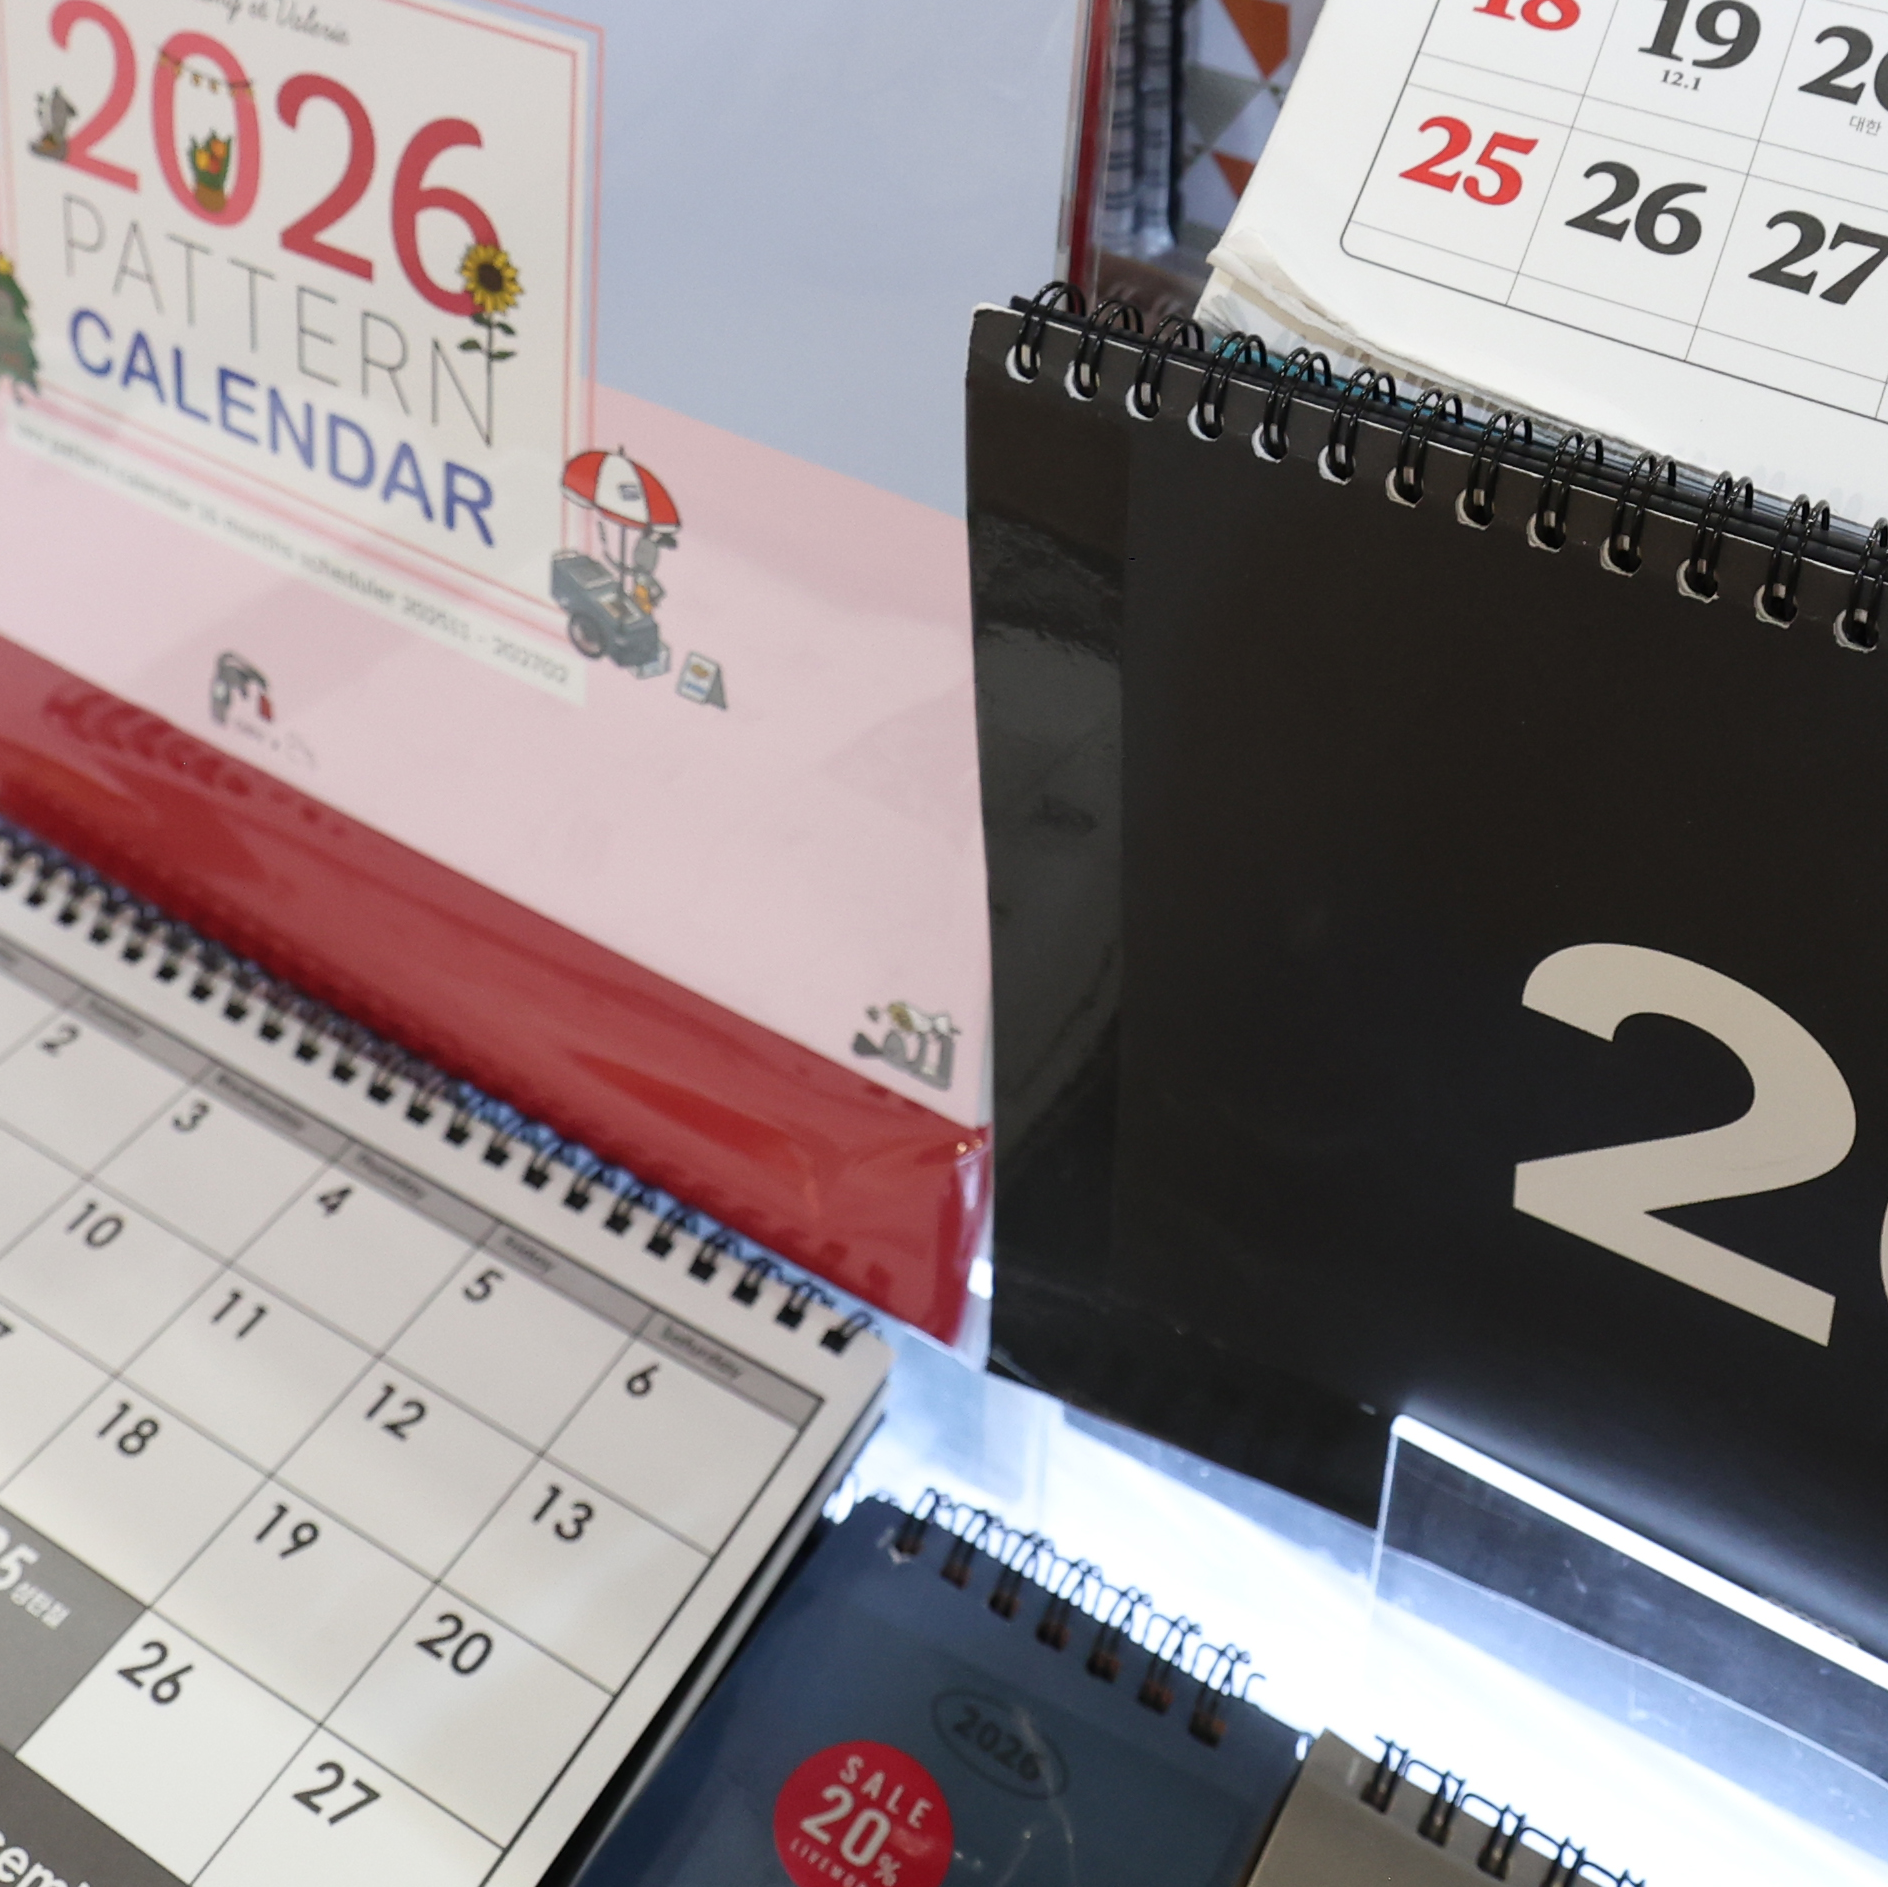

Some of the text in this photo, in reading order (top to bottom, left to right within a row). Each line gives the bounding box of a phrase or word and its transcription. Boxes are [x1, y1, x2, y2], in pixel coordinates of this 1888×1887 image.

[1662, 70, 1701, 91] 12.1
[1398, 115, 1539, 206] 25
[1564, 160, 1708, 256] 26
[57, 190, 496, 449] PATTERN
[67, 307, 498, 550] CALENDAR
[41, 1025, 80, 1054] 2
[172, 1100, 211, 1132] 3
[317, 1186, 353, 1215] 4
[463, 1268, 503, 1302] 5
[625, 1364, 659, 1397] 6
[67, 1201, 125, 1249] 10
[212, 1289, 268, 1338] 11
[366, 1383, 427, 1440] 12
[532, 1484, 595, 1542] 13
[98, 1401, 161, 1457] 18
[255, 1503, 320, 1559] 19
[415, 1612, 494, 1676] 20
[117, 1640, 194, 1706] 26
[292, 1760, 382, 1826] 27
[839, 1754, 934, 1829] SALE
[952, 1704, 1041, 1782] 2026
[800, 1784, 902, 1887] 20%
